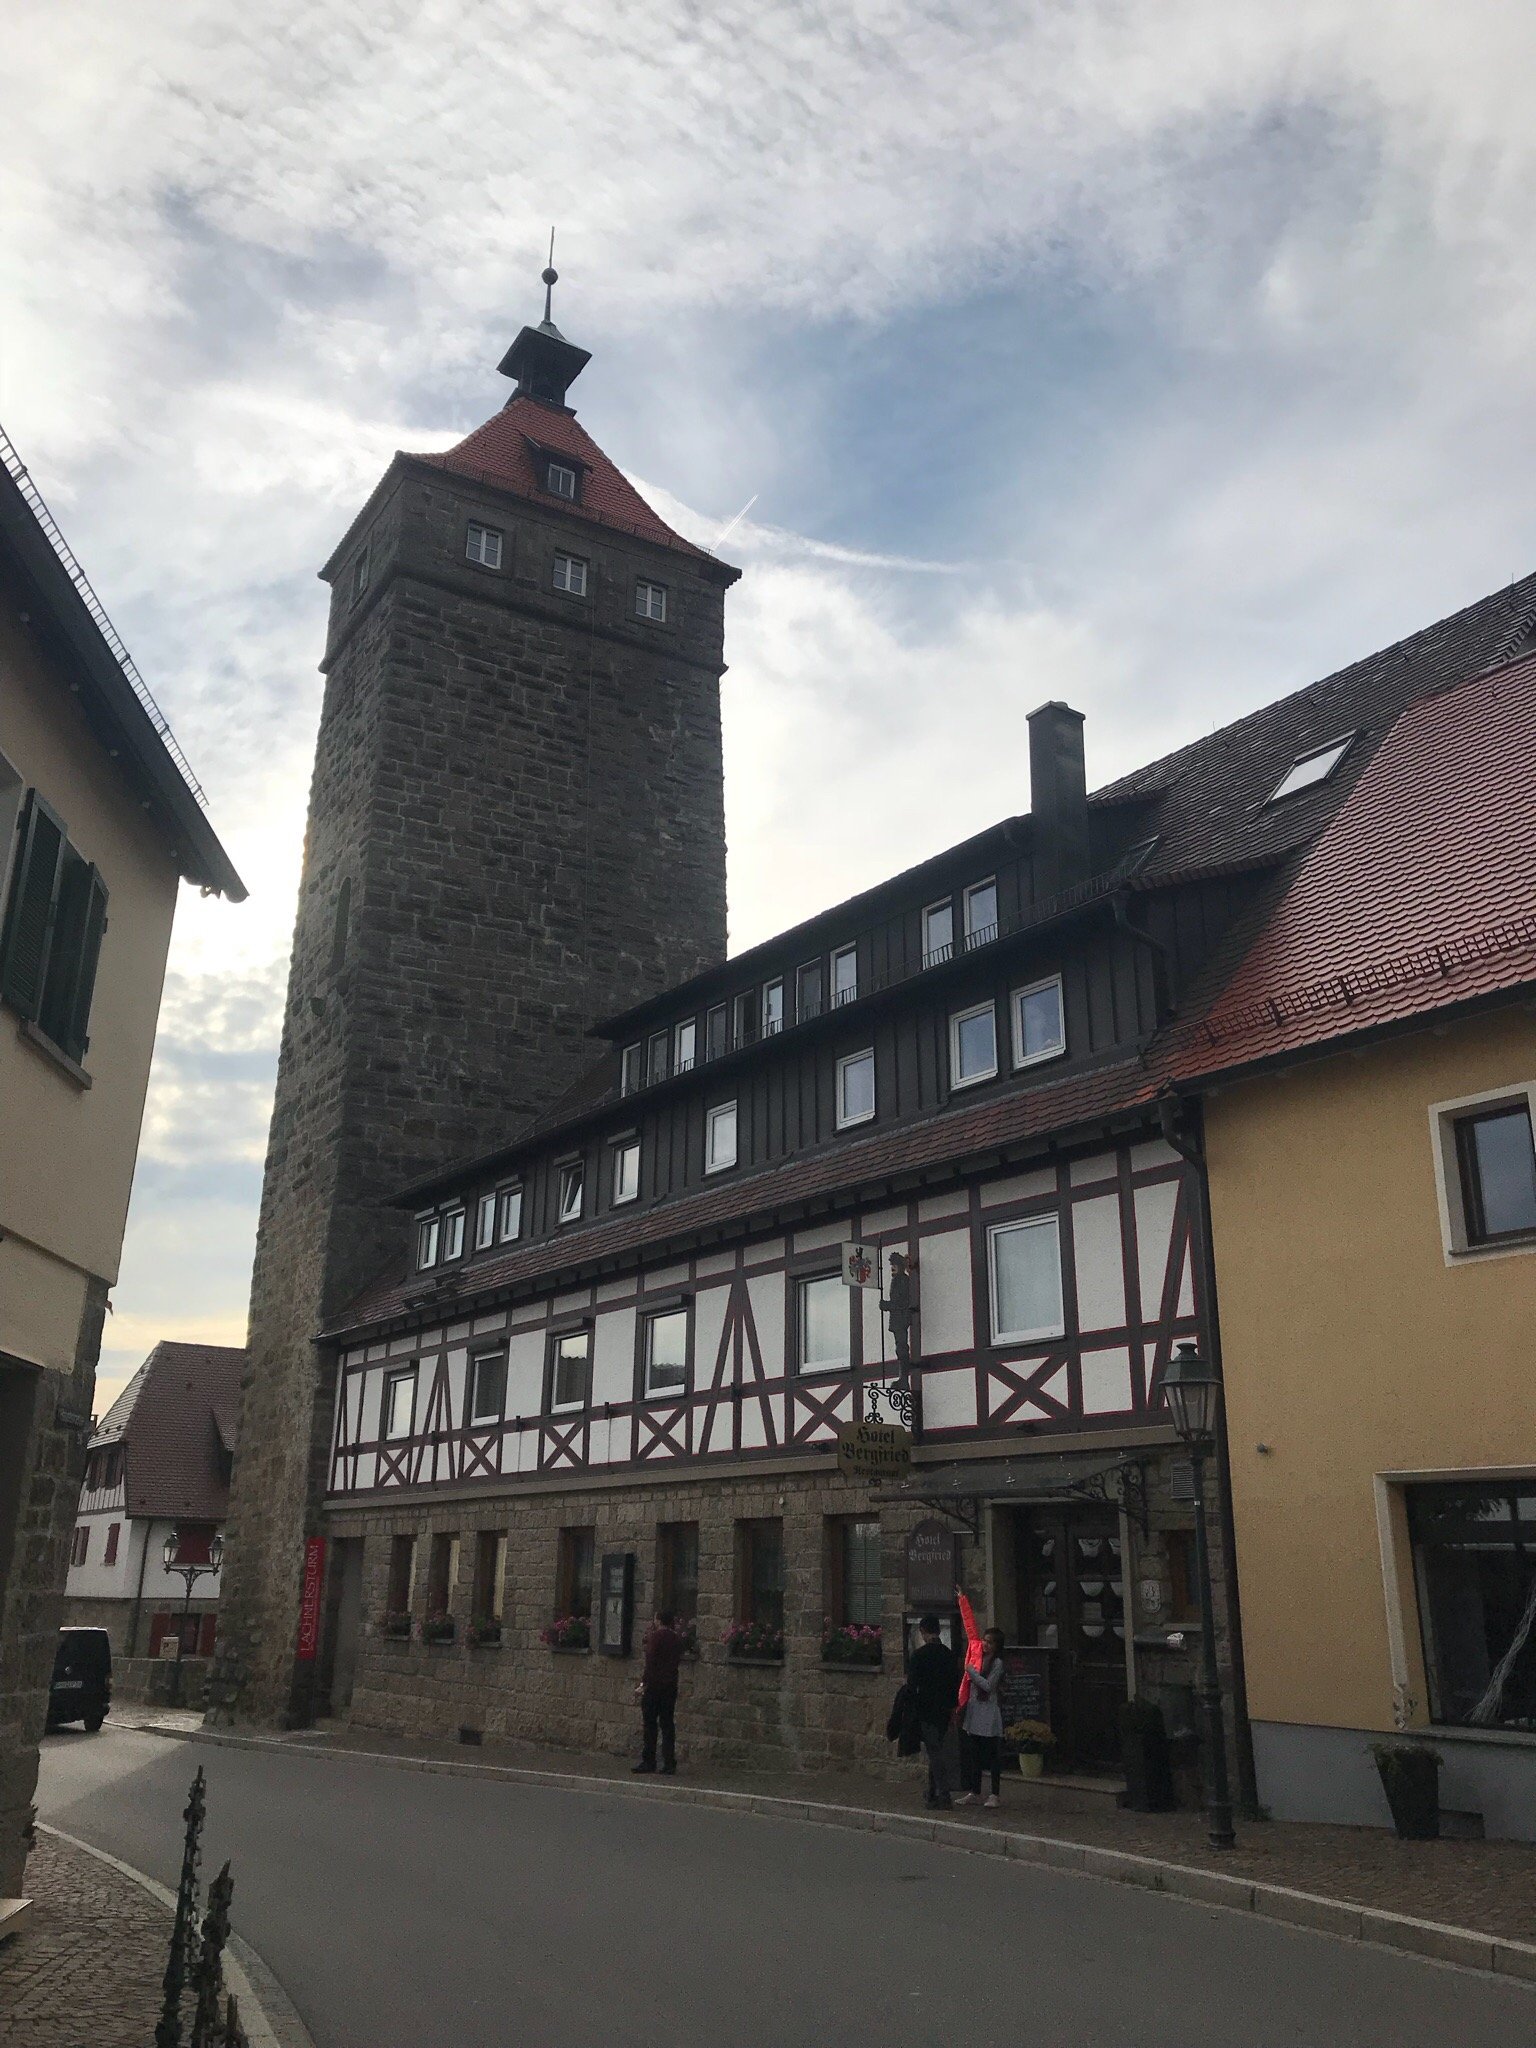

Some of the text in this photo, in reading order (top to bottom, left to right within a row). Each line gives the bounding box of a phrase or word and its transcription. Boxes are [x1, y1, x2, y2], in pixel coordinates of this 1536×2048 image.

[857, 1426, 895, 1444] Hotel
[842, 1441, 909, 1465] Bergfried
[915, 1534, 940, 1547] Hotel
[908, 1548, 952, 1564] Bergfried
[300, 1545, 319, 1651] LACHNERSTURM
